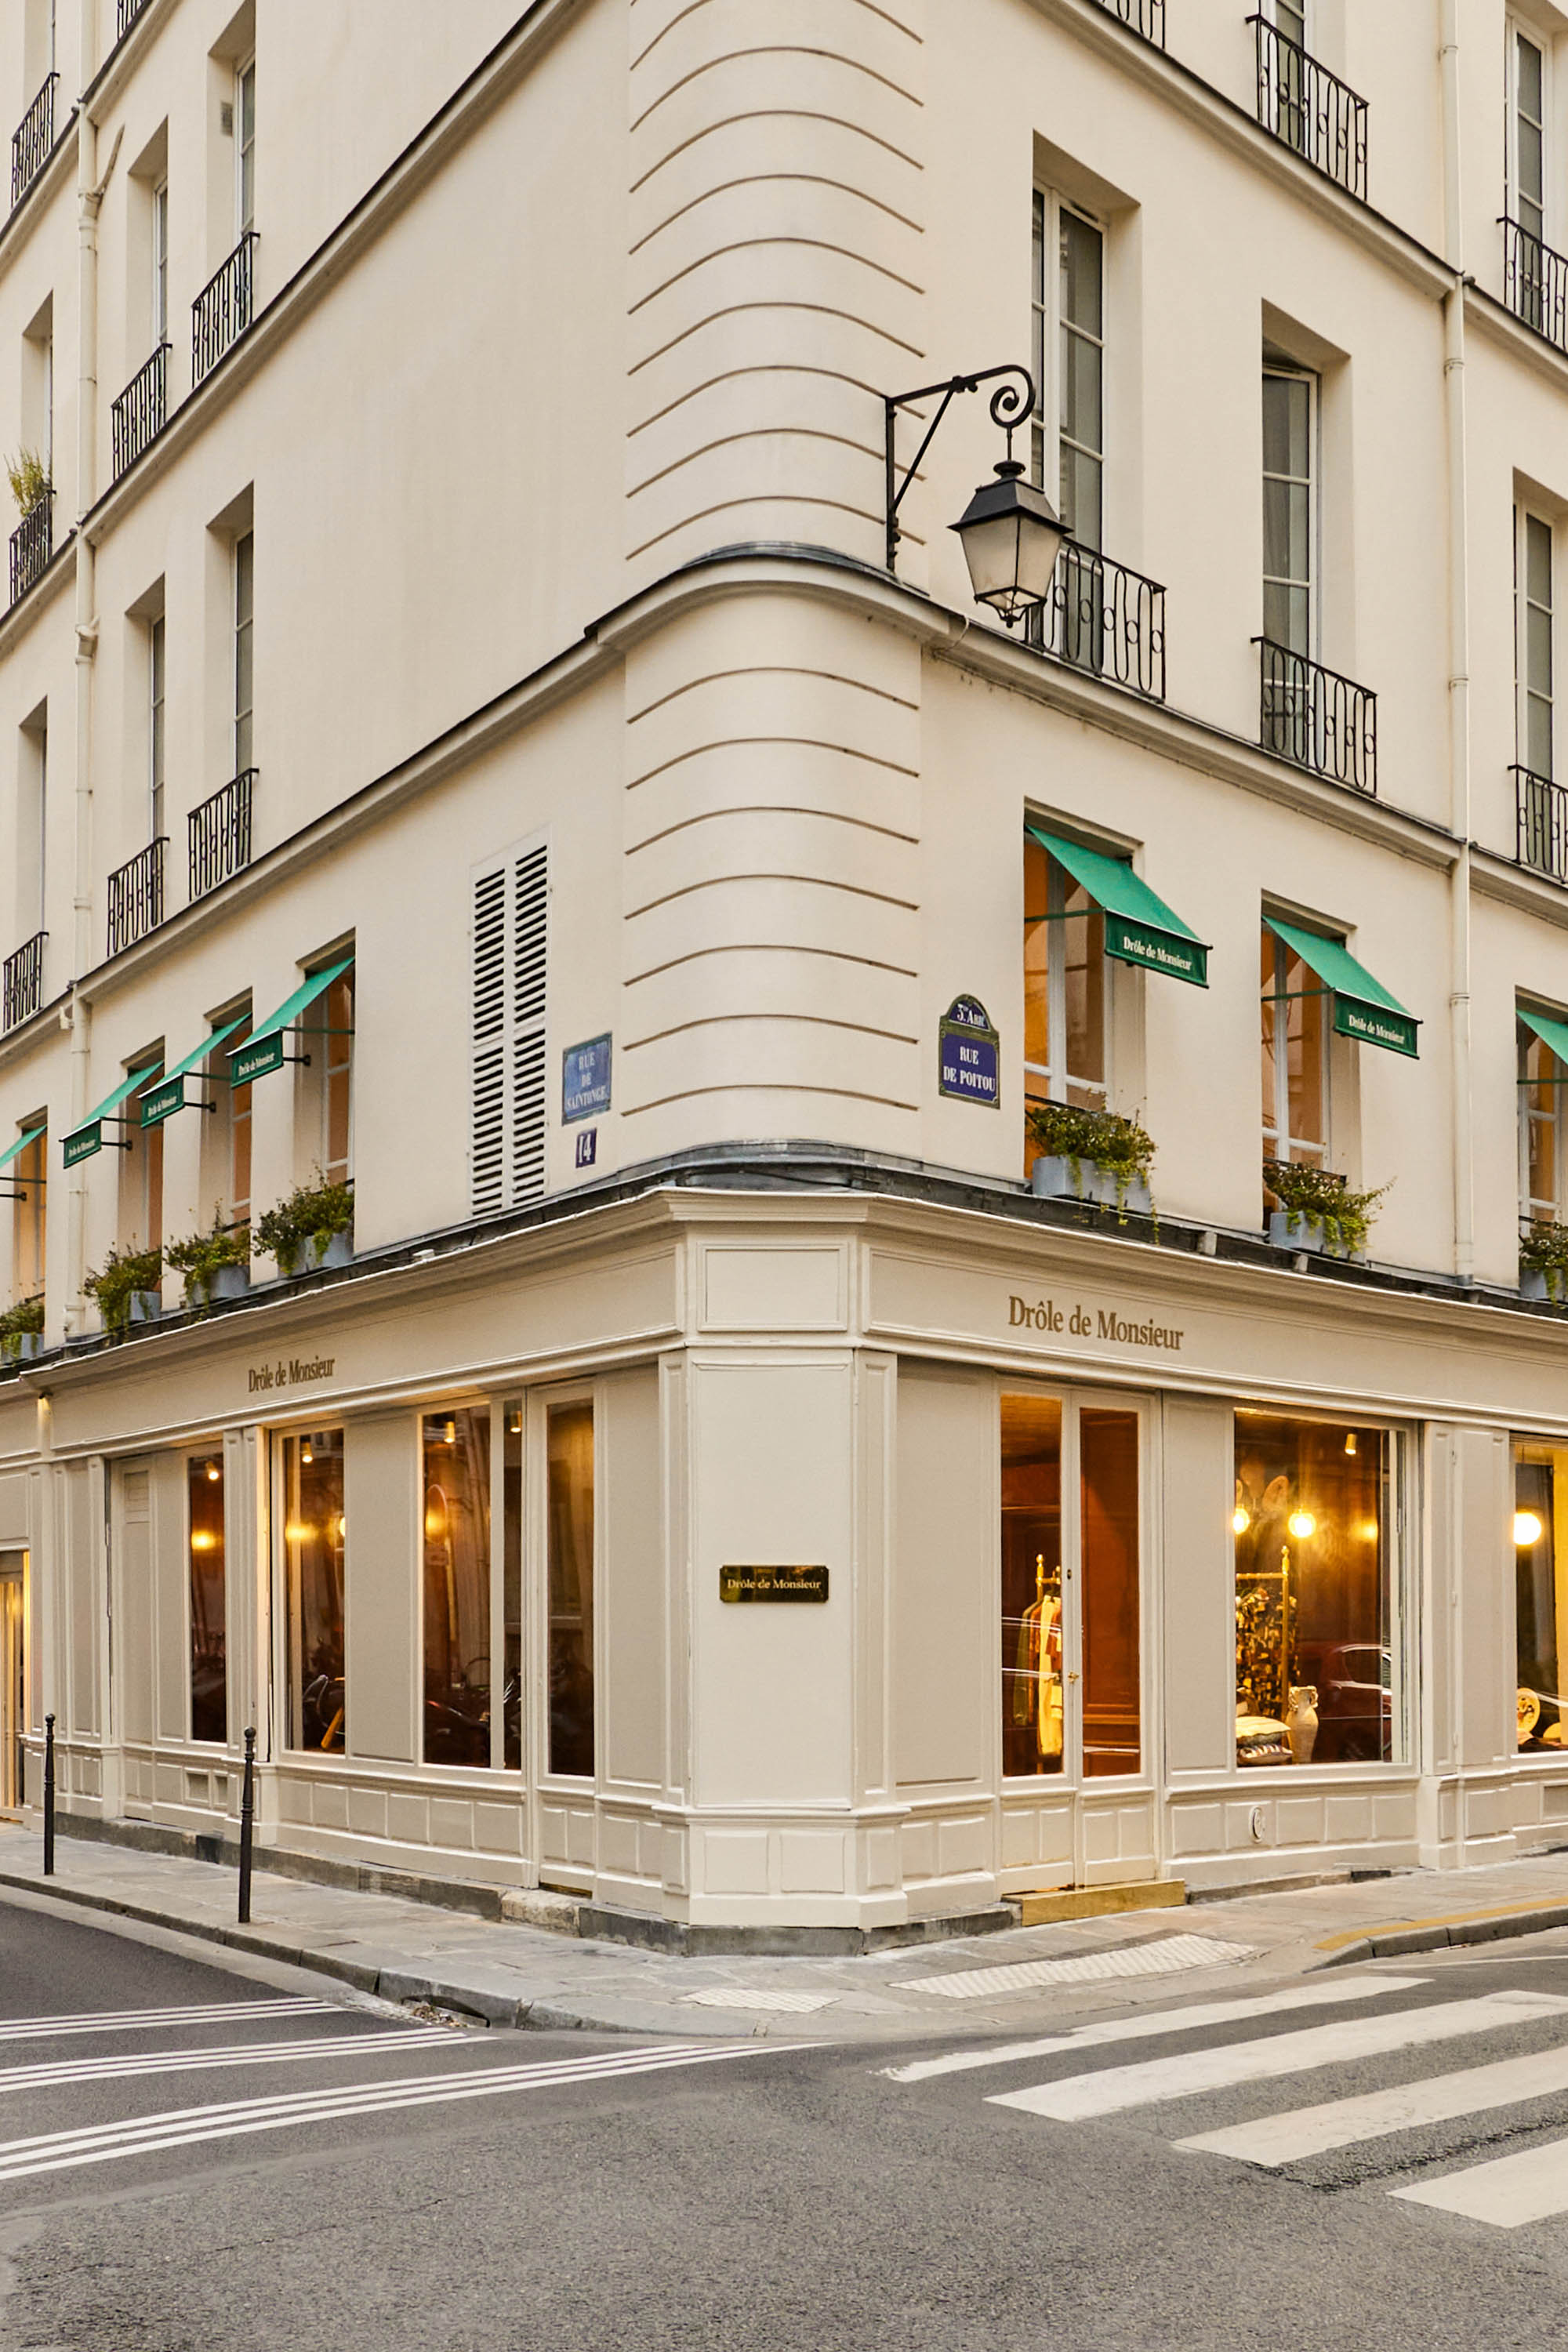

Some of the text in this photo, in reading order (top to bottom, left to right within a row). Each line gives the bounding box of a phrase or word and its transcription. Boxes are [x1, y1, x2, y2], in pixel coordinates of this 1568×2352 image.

[1146, 943, 1156, 959] de
[1367, 1021, 1376, 1034] de
[579, 1051, 596, 1071] RUE
[960, 1046, 978, 1065] RUE
[581, 1072, 593, 1087] DE
[943, 1065, 996, 1092] DE POITOU
[579, 1133, 592, 1163] 14
[1008, 1295, 1185, 1350] Drôle de Monsieur
[249, 1355, 336, 1392] Drôle de Monsieur
[727, 1578, 822, 1588] Drôle de Monsieur
